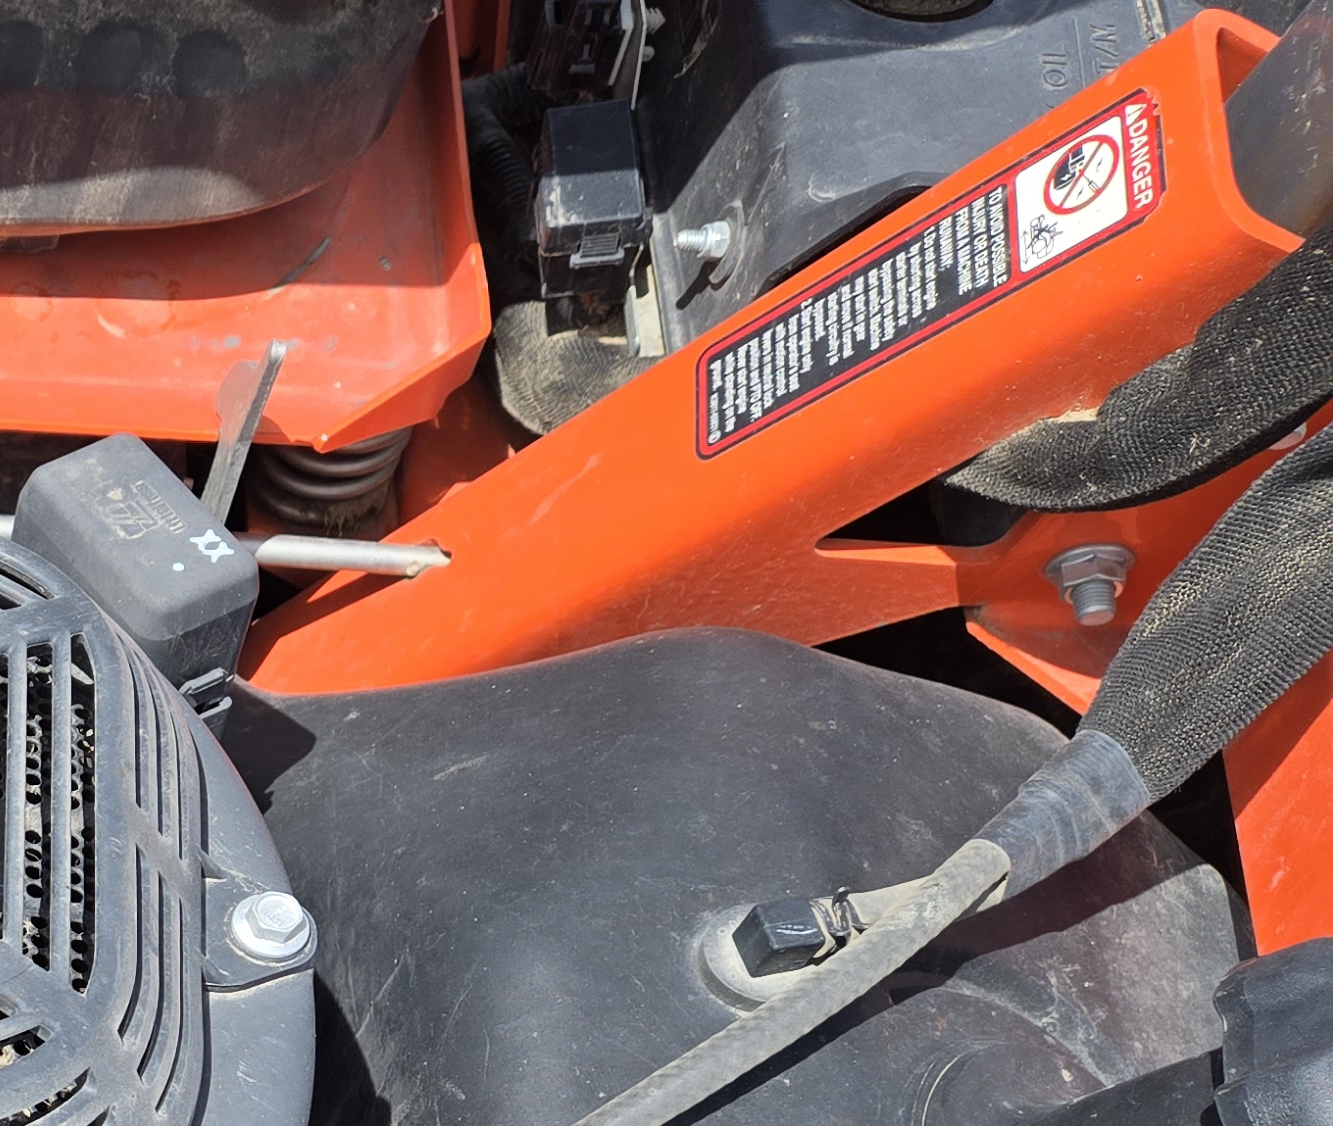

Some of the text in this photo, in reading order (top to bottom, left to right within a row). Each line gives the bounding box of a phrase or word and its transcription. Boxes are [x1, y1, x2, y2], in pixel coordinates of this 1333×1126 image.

[1128, 115, 1153, 211] DANGER
[922, 232, 935, 249] Do
[923, 244, 935, 264] not
[923, 259, 936, 283] start
[955, 205, 971, 296] FROM A MACHINE
[971, 195, 988, 289] INJURY OR DEATH
[988, 185, 1006, 288] TO AVOID POSSIBLE
[907, 241, 922, 320] by shorting across
[924, 279, 936, 312] engine
